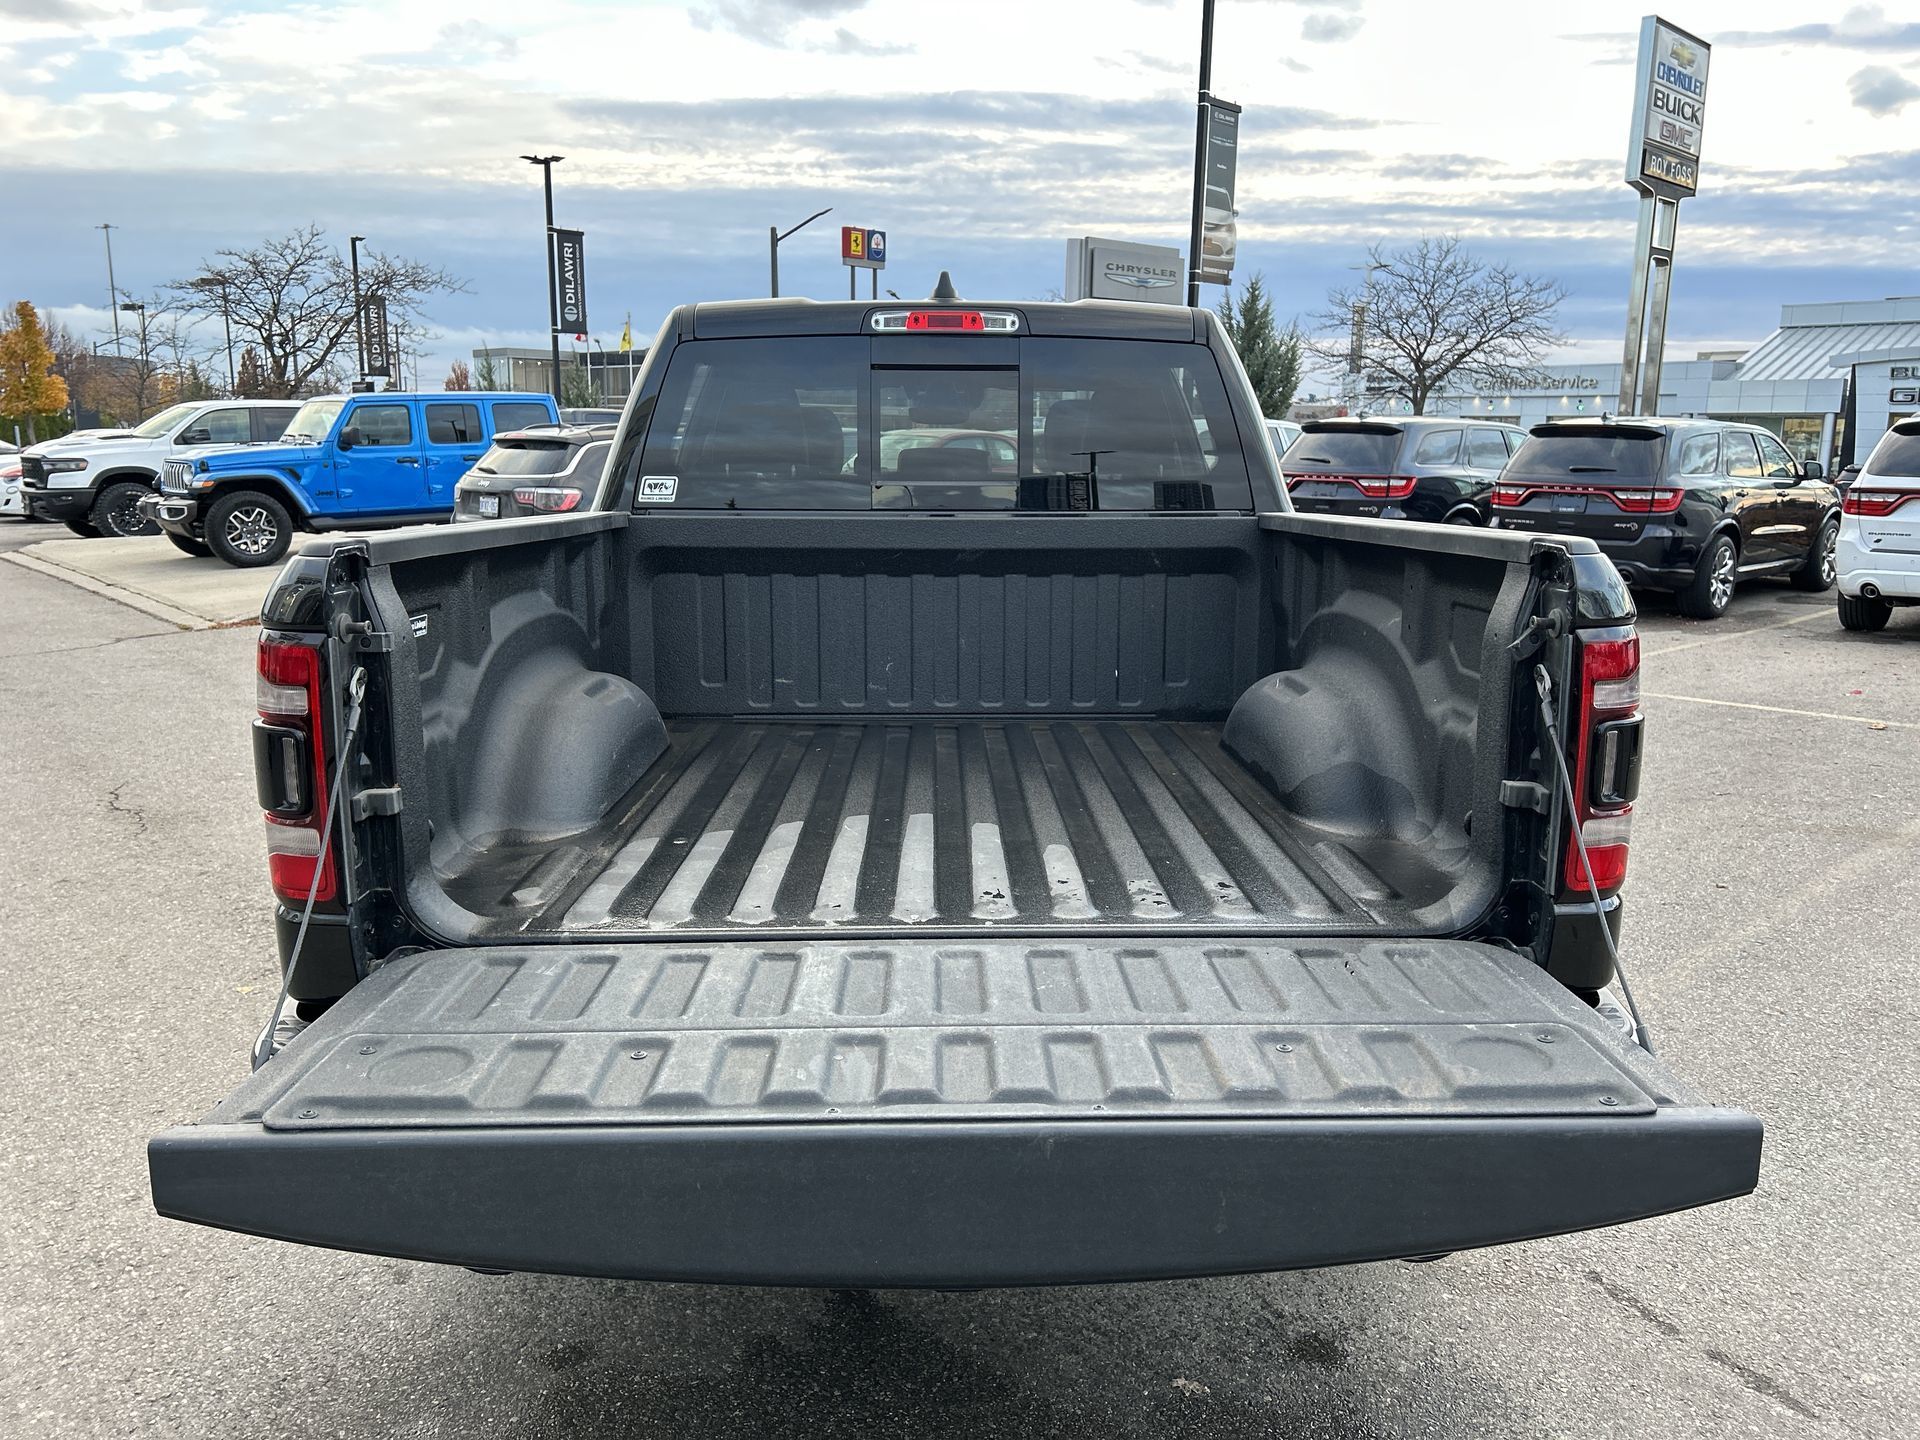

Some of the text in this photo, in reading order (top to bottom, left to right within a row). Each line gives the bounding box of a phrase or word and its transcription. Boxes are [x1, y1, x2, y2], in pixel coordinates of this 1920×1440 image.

[1657, 61, 1704, 97] CHEVROLET
[1653, 89, 1702, 126] BUICK
[1659, 120, 1693, 150] GMC
[1650, 155, 1692, 183] ROY FOSS
[563, 242, 575, 304] DILAWRI
[1106, 262, 1177, 278] CHRYSLER
[1541, 375, 1599, 390] Service
